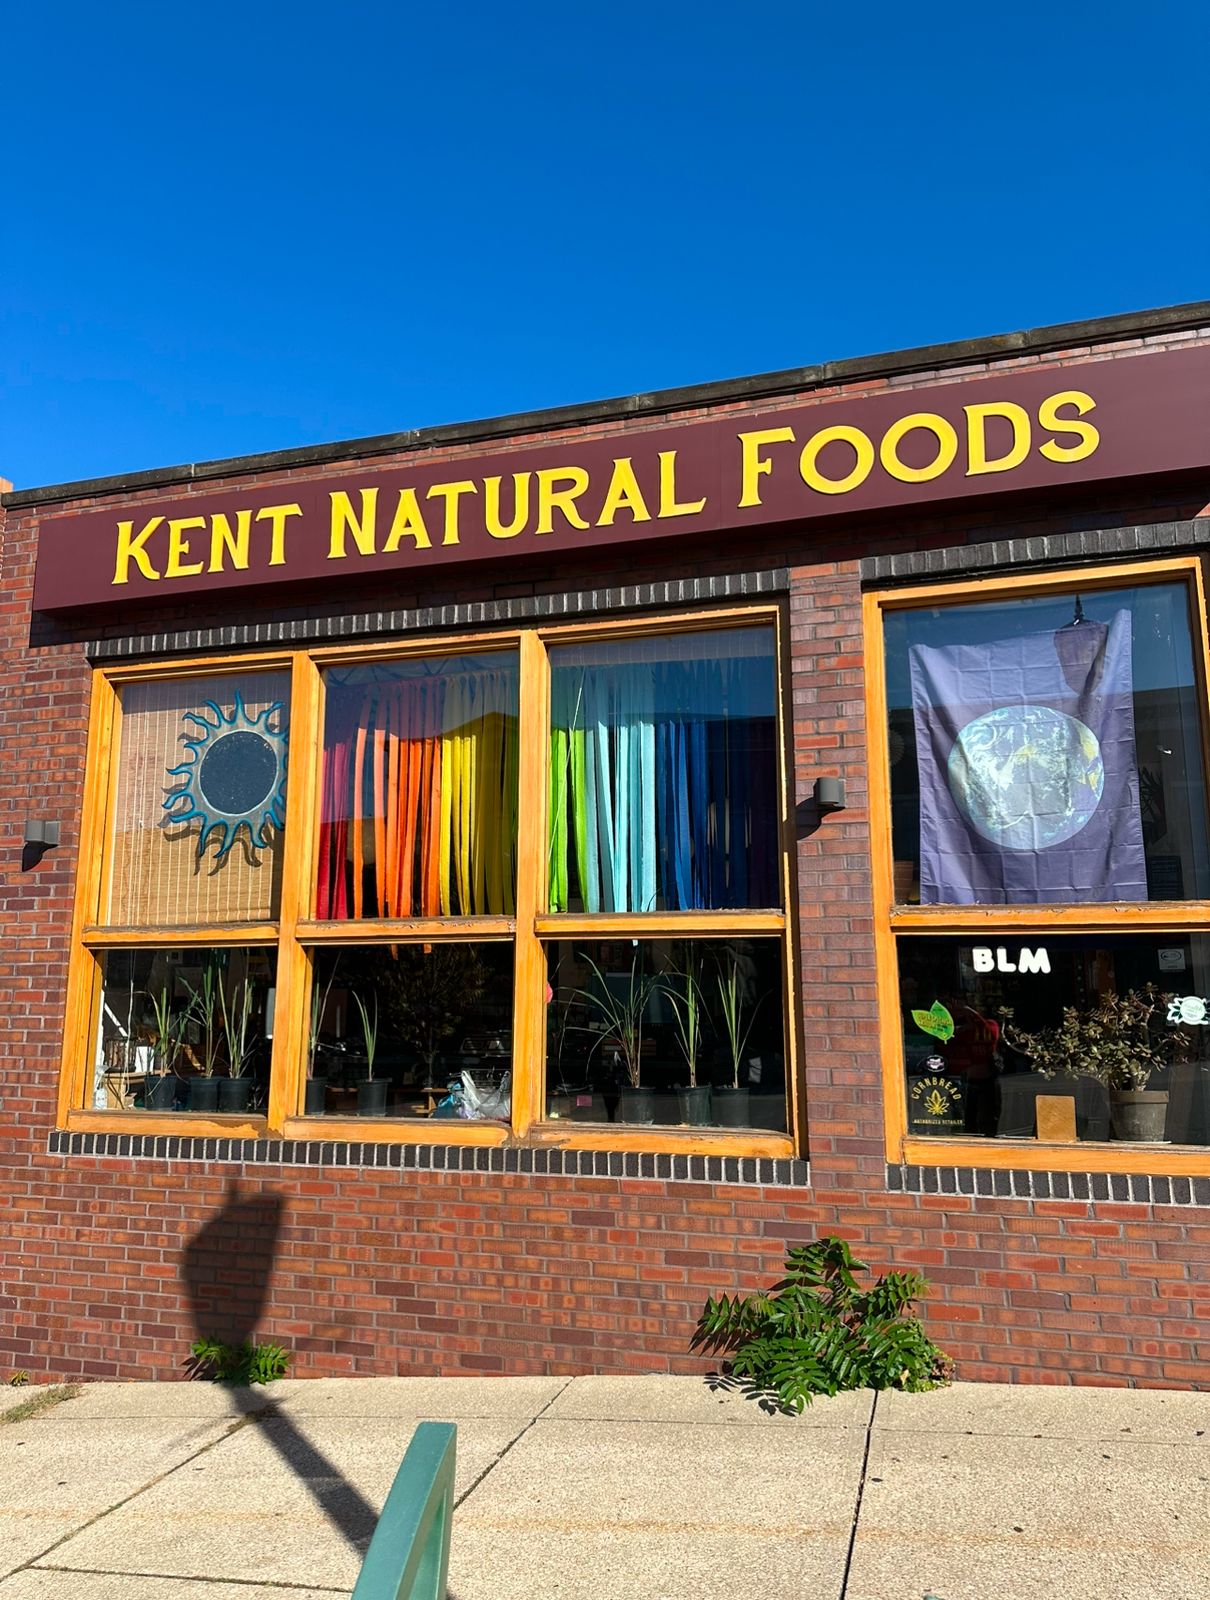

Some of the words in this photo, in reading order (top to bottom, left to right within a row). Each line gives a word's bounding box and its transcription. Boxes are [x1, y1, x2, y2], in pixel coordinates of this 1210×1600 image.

[112, 503, 303, 585] KENT
[327, 450, 707, 559] NATURAL
[737, 390, 1100, 508] FOODS
[972, 946, 1051, 974] BLM
[911, 1076, 962, 1100] CORNBREAD
